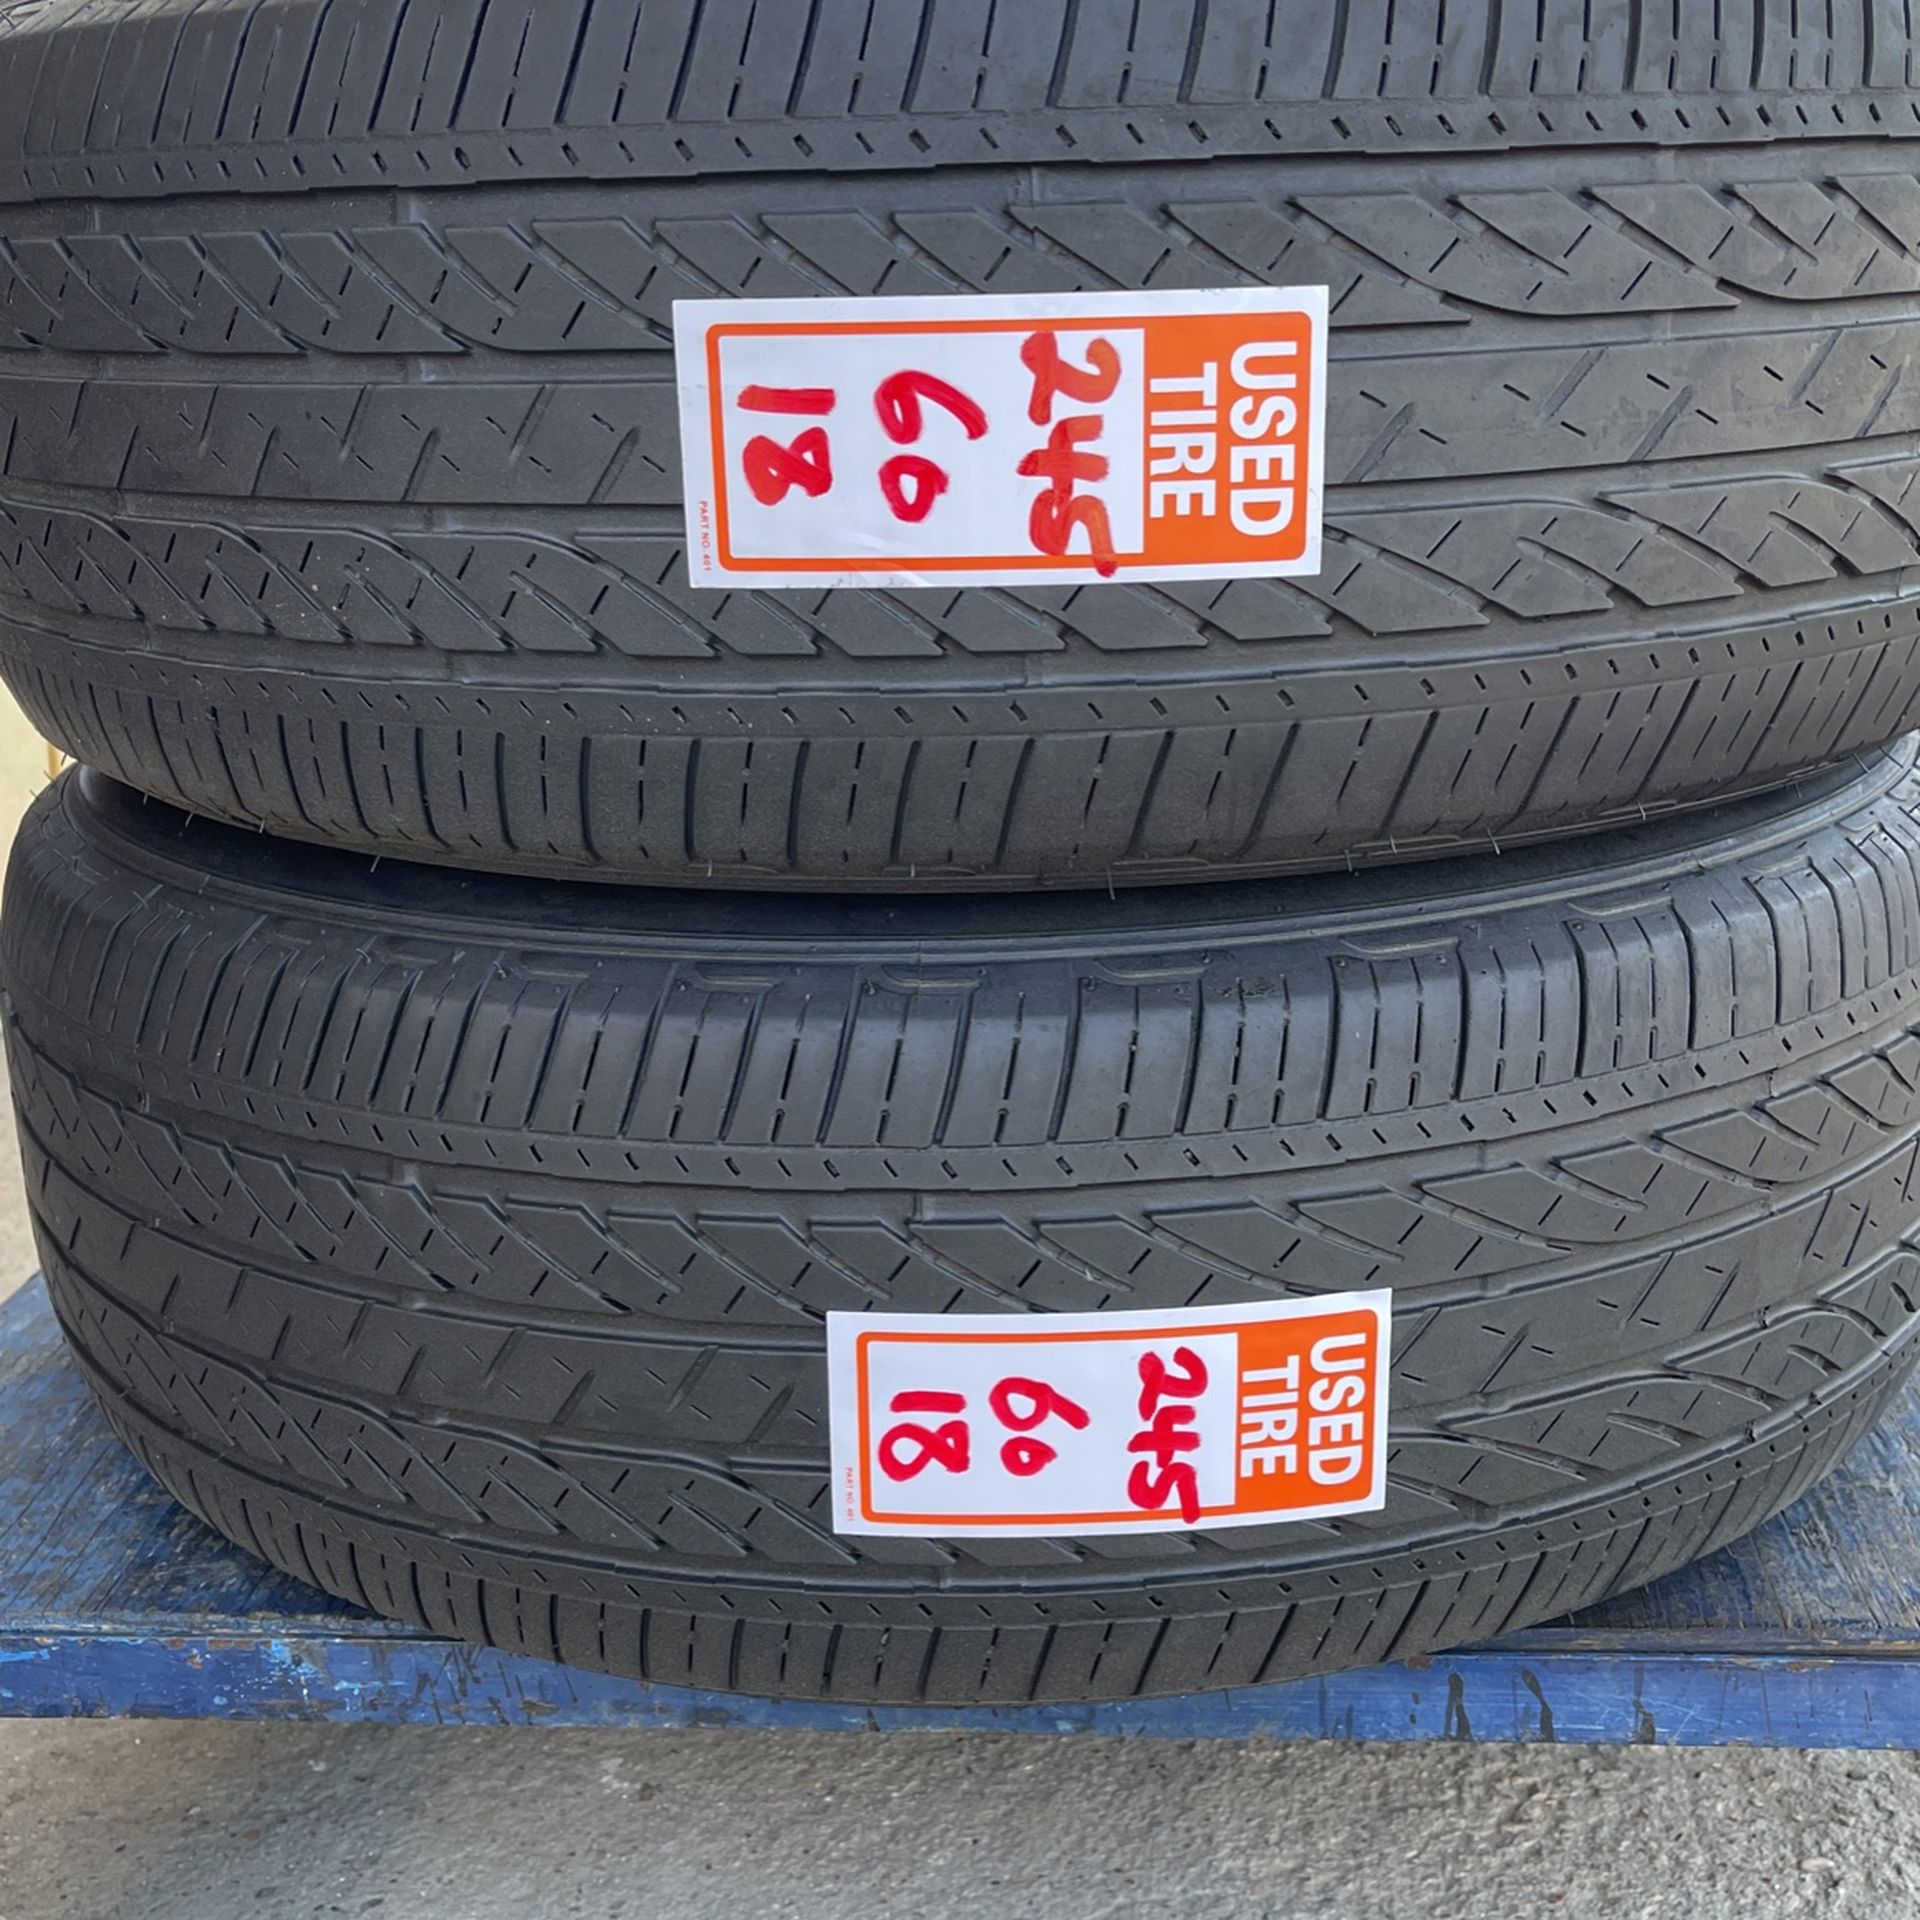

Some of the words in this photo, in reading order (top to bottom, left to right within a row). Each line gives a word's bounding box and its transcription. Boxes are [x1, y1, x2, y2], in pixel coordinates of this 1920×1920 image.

[736, 383, 837, 506] 18
[873, 369, 988, 523] 60
[1018, 330, 1122, 579] 245
[1149, 361, 1218, 519] TIRE
[1229, 340, 1298, 537] USED
[699, 500, 710, 529] PART
[846, 1467, 854, 1489] PART
[878, 1390, 971, 1482] 18
[989, 1376, 1091, 1478] 60
[1127, 1346, 1209, 1525] 245
[1241, 1354, 1300, 1479] TIRE
[1308, 1332, 1367, 1486] USED
